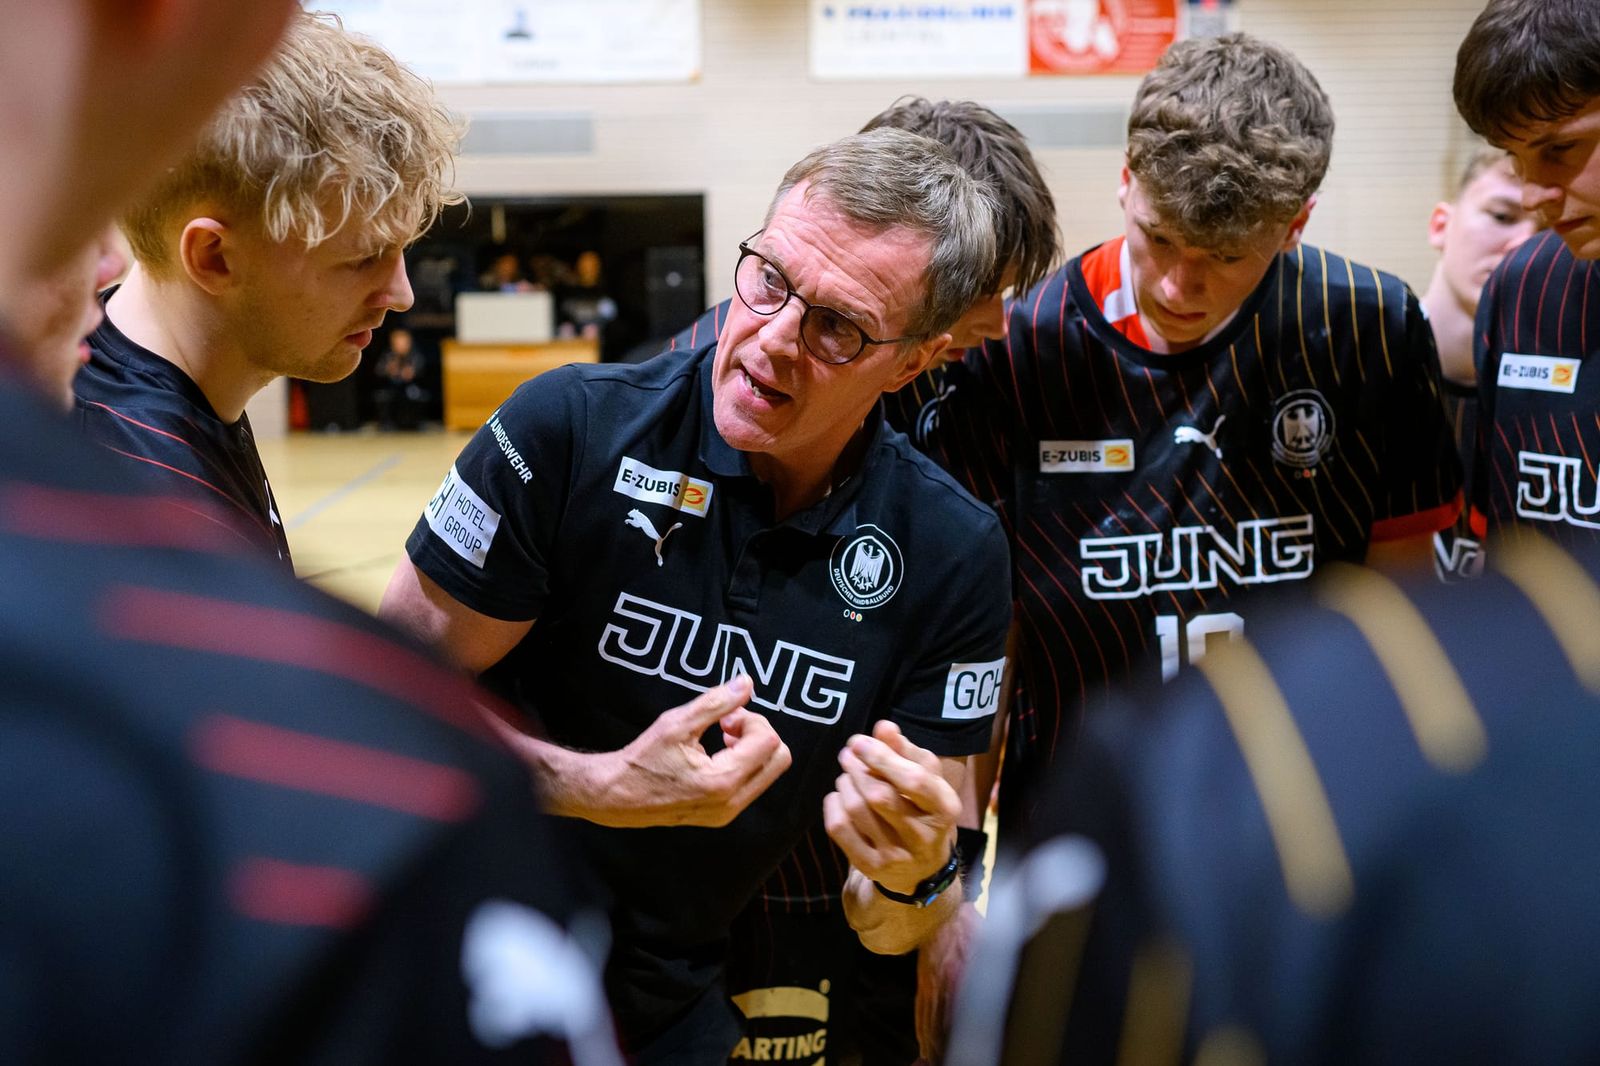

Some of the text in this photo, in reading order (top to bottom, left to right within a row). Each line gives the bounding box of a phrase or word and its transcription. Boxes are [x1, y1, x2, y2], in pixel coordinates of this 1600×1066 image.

[1041, 449, 1102, 464] E-ZUBIS
[621, 468, 681, 497] E-ZUBIS
[454, 492, 486, 532] HOTEL
[444, 515, 483, 553] GROUP
[1079, 513, 1314, 600] JUNG
[833, 567, 894, 606] DEUTSCHER HANDBALLBUND
[597, 591, 856, 726] JUNG
[952, 668, 1002, 711] GCH
